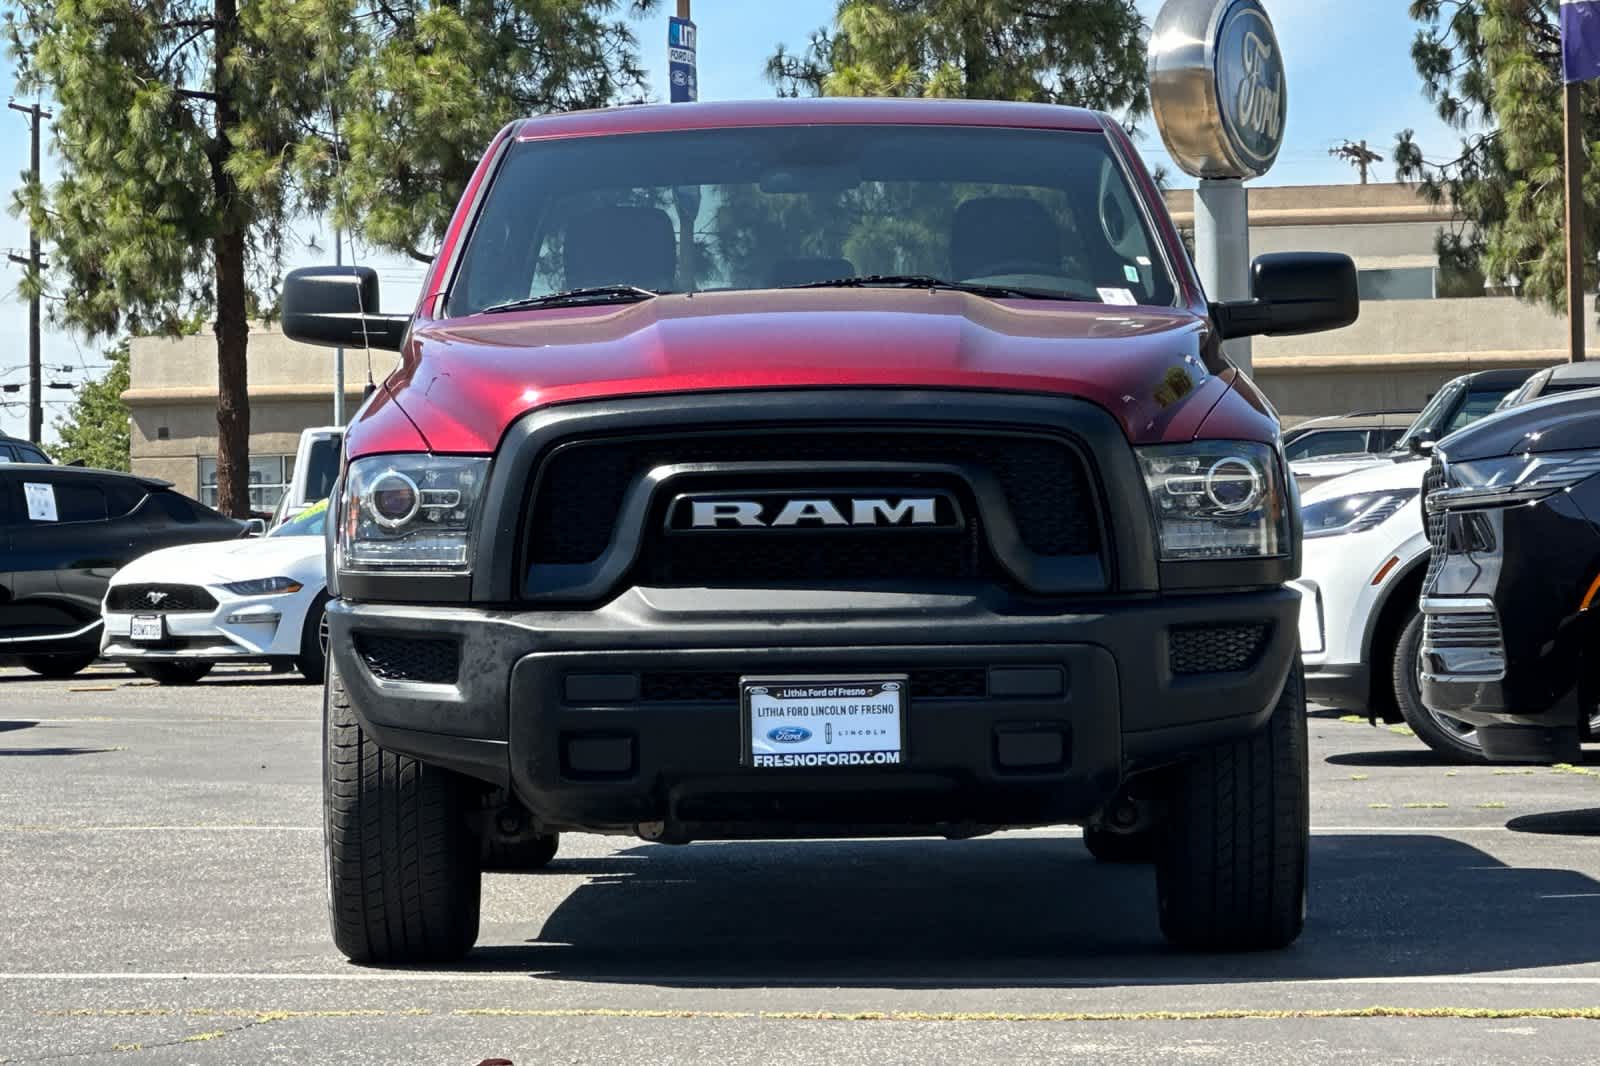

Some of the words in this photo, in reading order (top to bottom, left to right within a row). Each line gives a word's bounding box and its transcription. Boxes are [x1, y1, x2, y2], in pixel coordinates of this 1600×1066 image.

[1238, 31, 1281, 140] Ford
[692, 498, 936, 527] RAM
[783, 688, 807, 698] Lithia
[808, 688, 828, 697] Ford
[828, 688, 838, 697] of
[838, 687, 866, 697] Fresno
[758, 706, 785, 718] LITHIA
[787, 706, 809, 717] FORD
[811, 704, 847, 717] LINCOLN
[848, 704, 859, 716] OF
[861, 703, 894, 716] FRESNO
[776, 728, 804, 741] Ford
[838, 729, 887, 737] LINCOLN
[753, 751, 900, 768] FRESNOFORD.COM
